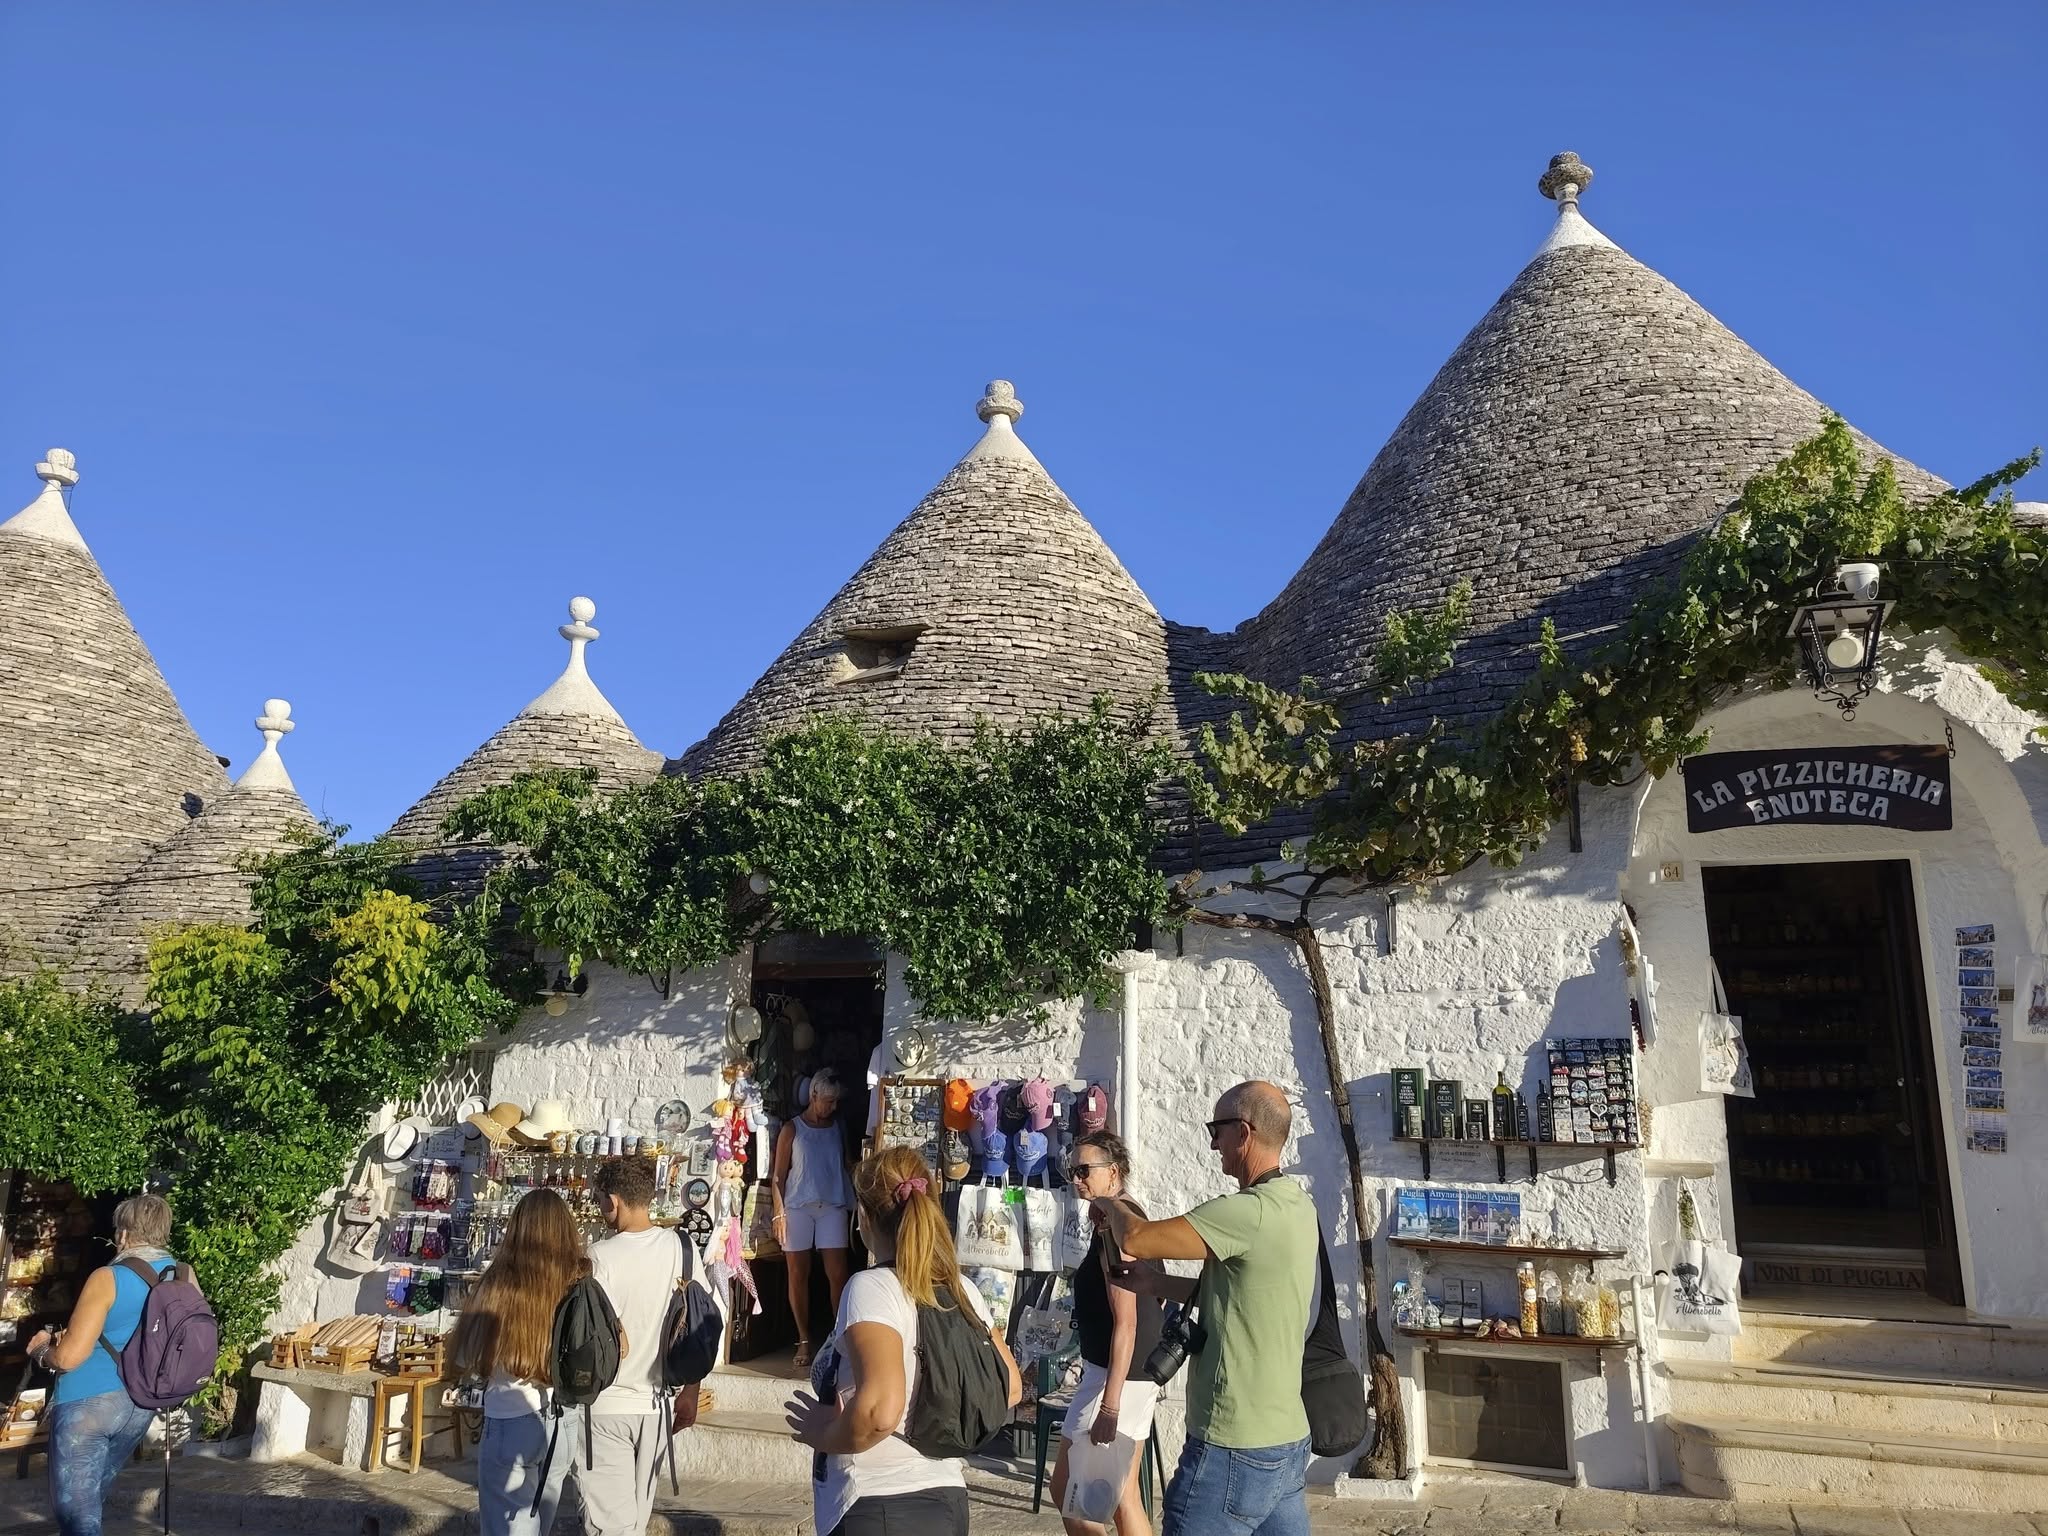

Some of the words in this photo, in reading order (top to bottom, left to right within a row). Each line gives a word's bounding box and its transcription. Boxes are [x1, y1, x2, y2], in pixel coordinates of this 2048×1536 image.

[1692, 780, 1735, 813] LA
[1737, 760, 1944, 806] PIZZICHERIA
[1746, 789, 1889, 823] ENOTECA
[1663, 866, 1680, 878] 64
[1401, 1188, 1425, 1198] Puglia
[1491, 1192, 1518, 1203] Apulia
[963, 1244, 1009, 1257] Alberobello
[1759, 1263, 1801, 1281] VINI
[1810, 1267, 1832, 1283] DI
[1842, 1268, 1921, 1288] PUGLIA
[1676, 1303, 1721, 1316] Alberobello
